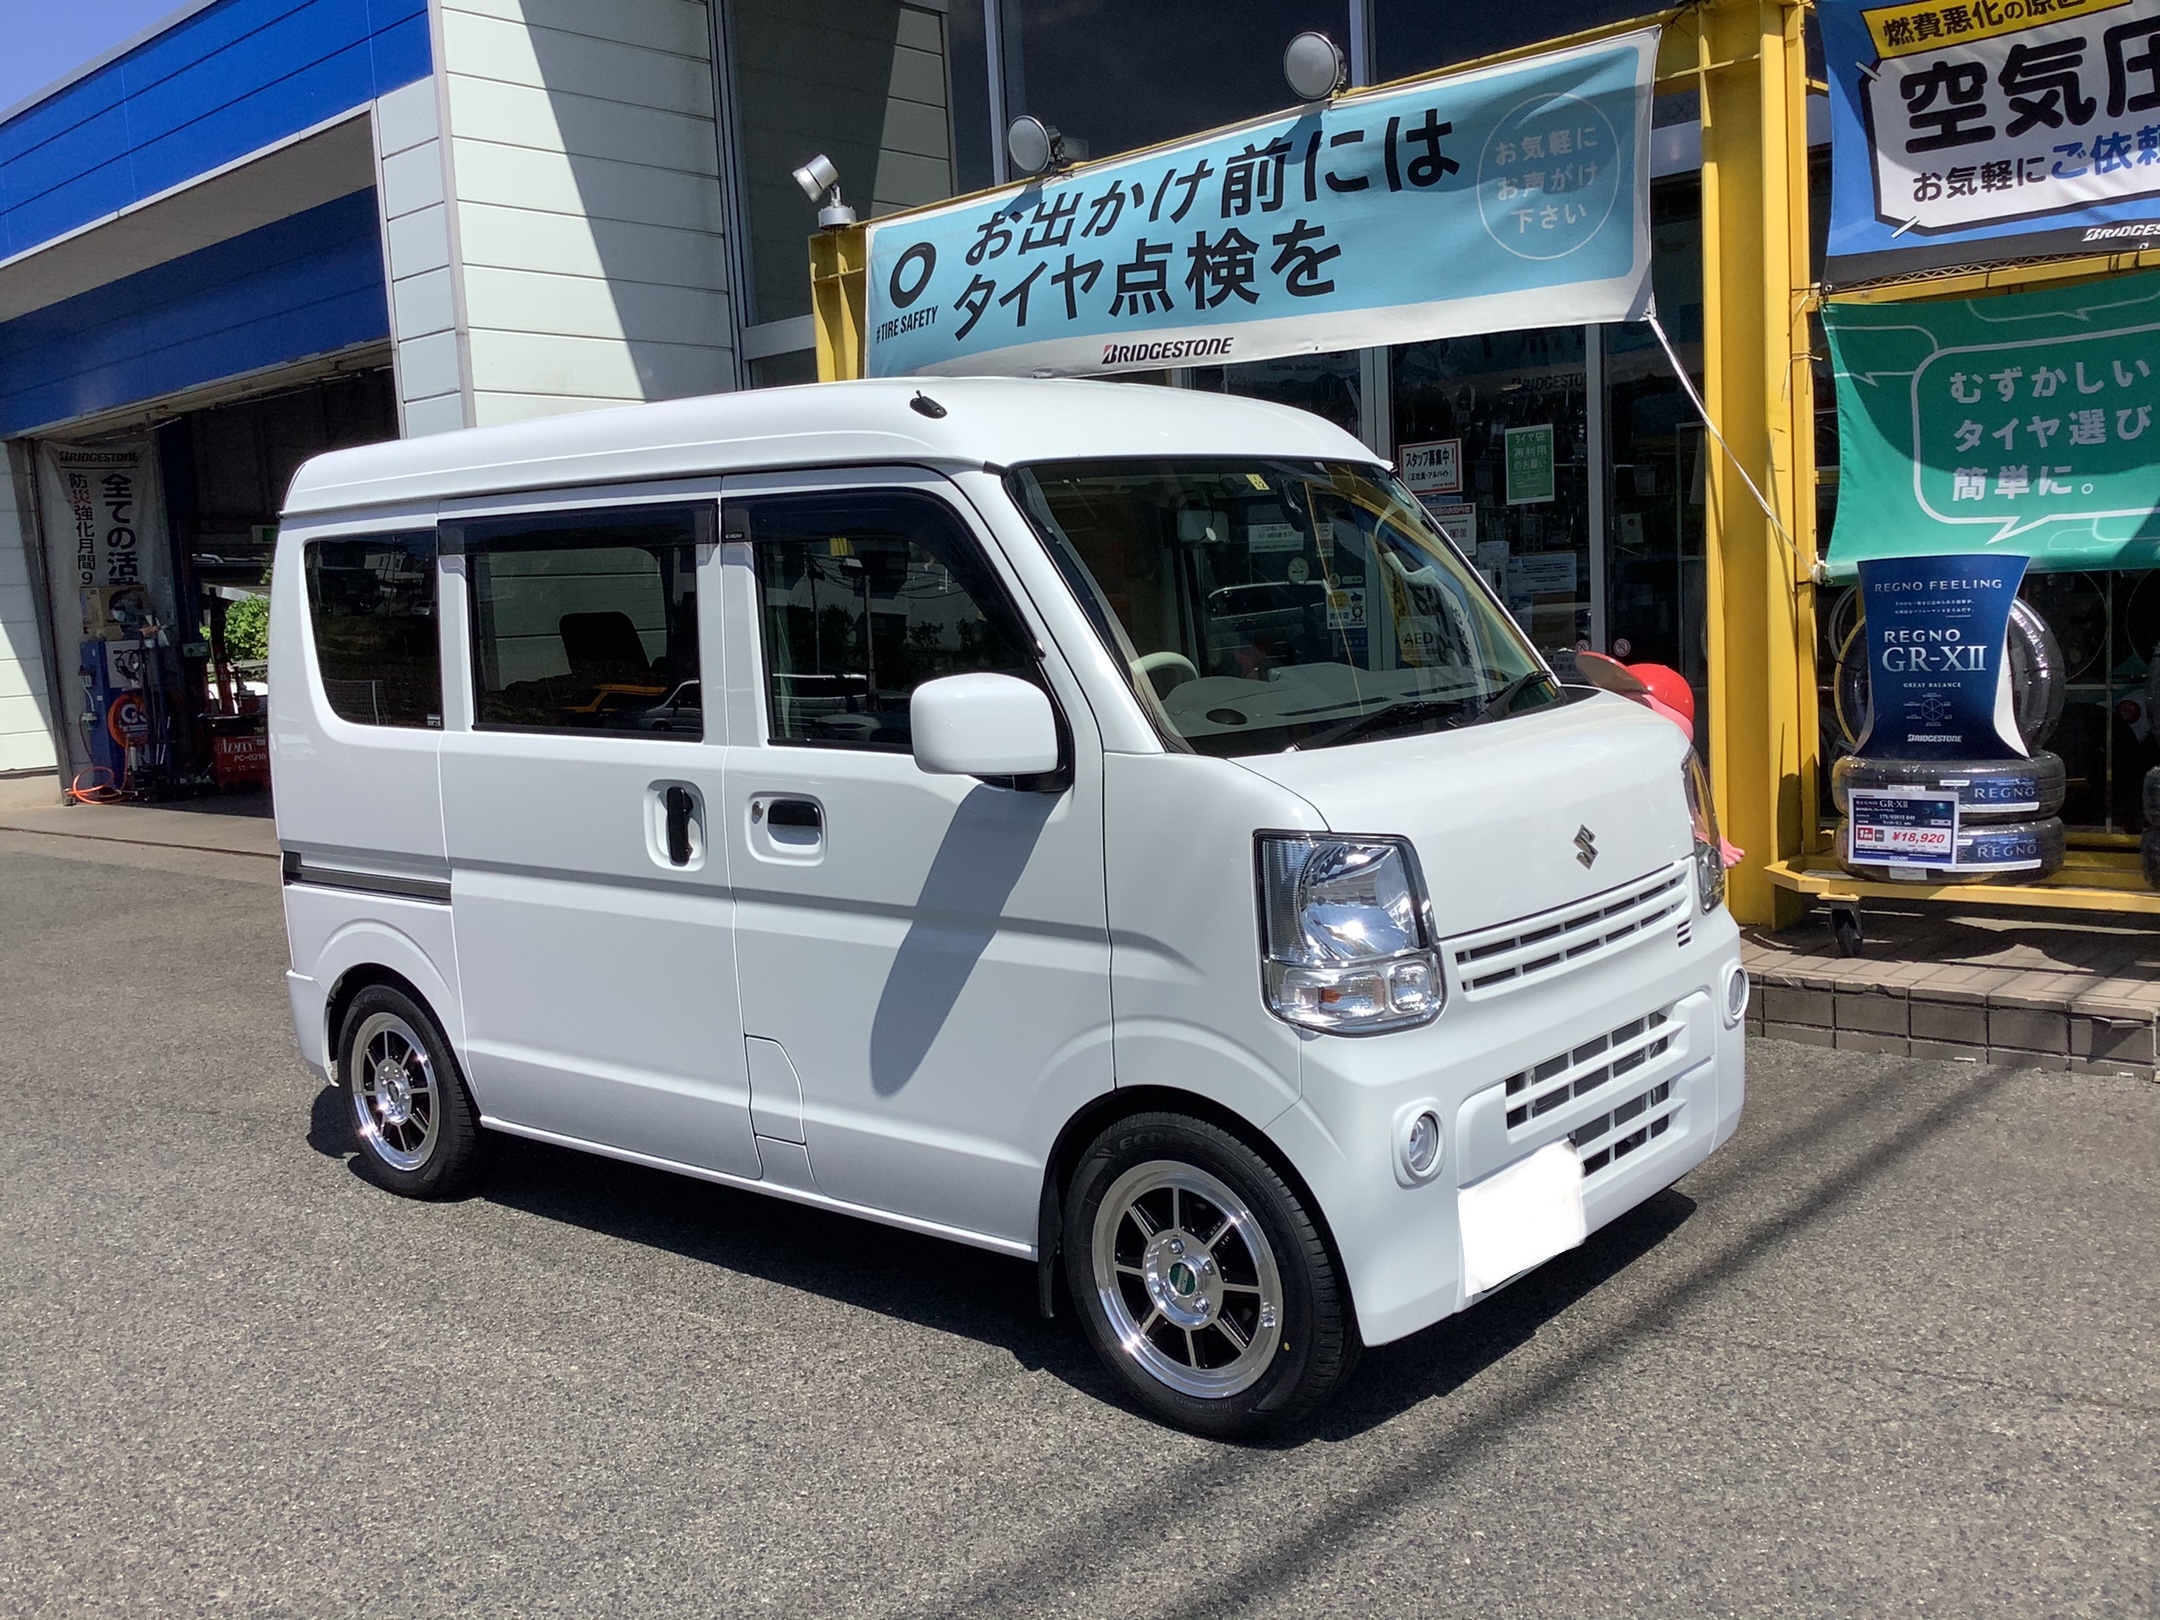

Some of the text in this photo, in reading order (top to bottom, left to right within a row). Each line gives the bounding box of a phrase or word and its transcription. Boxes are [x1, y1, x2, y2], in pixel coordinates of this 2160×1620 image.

[1495, 127, 1598, 165] お気軽に
[965, 108, 1461, 266] お出かけ前には
[1497, 161, 1598, 201] お声がけ
[1510, 204, 1586, 234] 下さい
[953, 219, 1341, 342] タイヤ点検を
[877, 305, 939, 343] #TIRE SAFETY
[1102, 337, 1234, 365] BRIDGESTONE
[1949, 359, 2151, 404] むずかしい
[1954, 404, 2153, 452] タイヤ選び
[60, 451, 139, 463] BRIDGESTONE
[1514, 444, 1547, 458] 再利用
[1514, 458, 1547, 471] のお願い
[1953, 464, 2095, 501] 簡単に。
[1874, 579, 2002, 593] REGNO FEELING
[1404, 631, 1434, 645] AED
[1884, 629, 1961, 644] REGNO
[1907, 734, 1963, 743] BRIDGESTONE
[1974, 786, 2035, 799] REGNO
[1892, 831, 1945, 844] ¥18,920
[1977, 844, 2037, 858] REGNO
